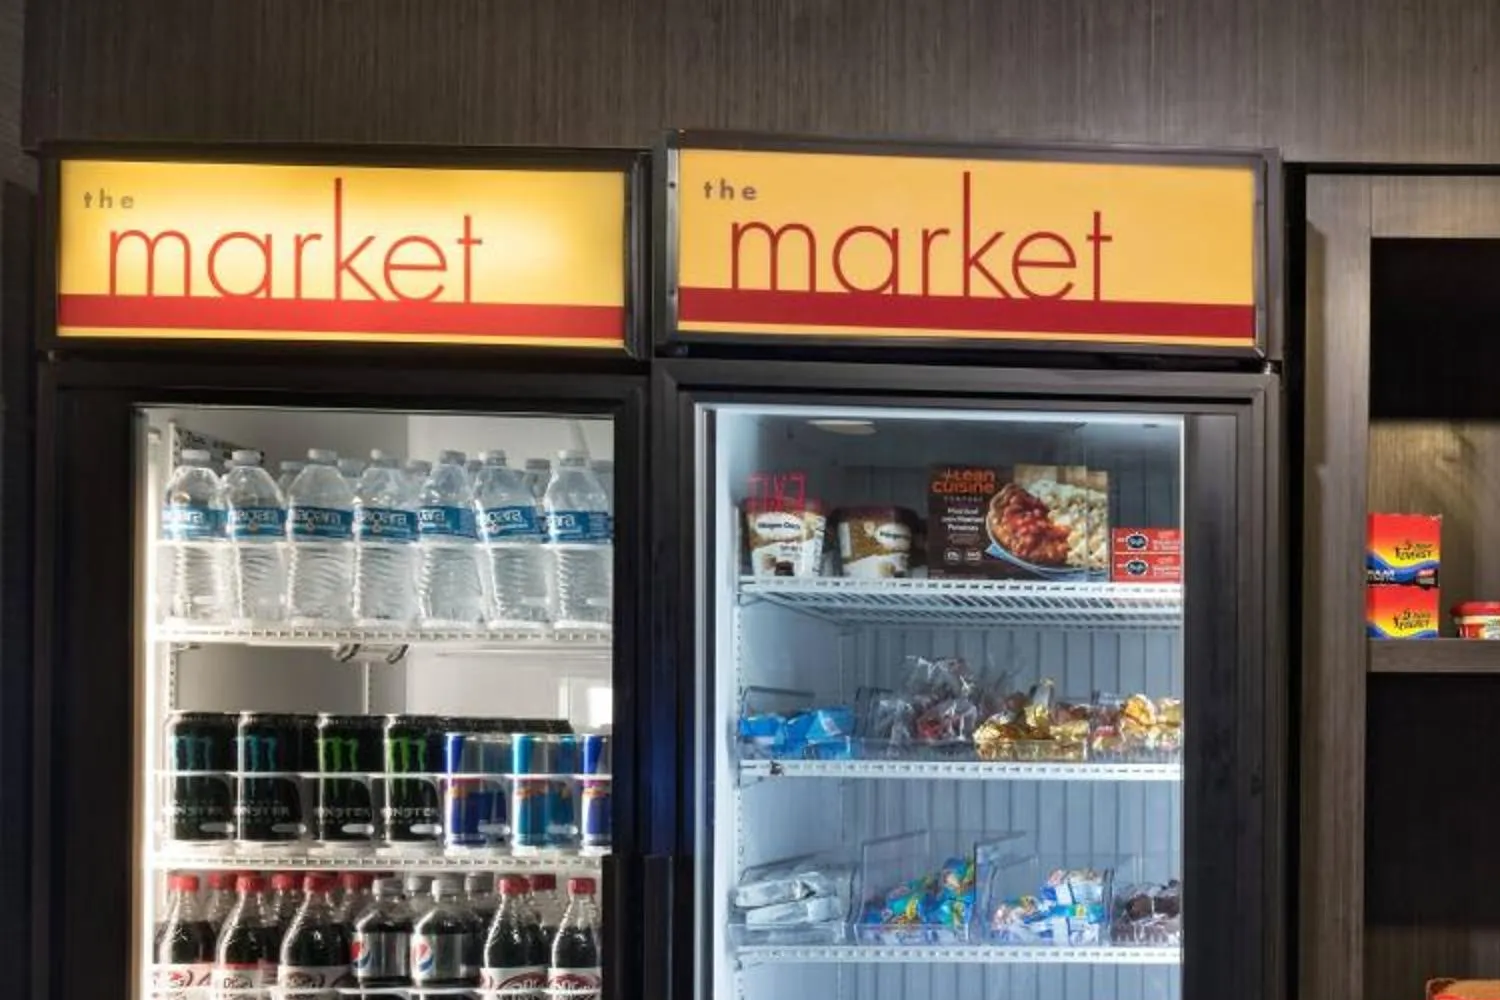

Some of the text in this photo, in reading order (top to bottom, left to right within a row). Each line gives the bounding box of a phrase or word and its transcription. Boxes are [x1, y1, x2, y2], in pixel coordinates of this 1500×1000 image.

[83, 189, 135, 210] the
[704, 180, 757, 201] the
[108, 176, 483, 303] market
[732, 171, 1112, 300] market
